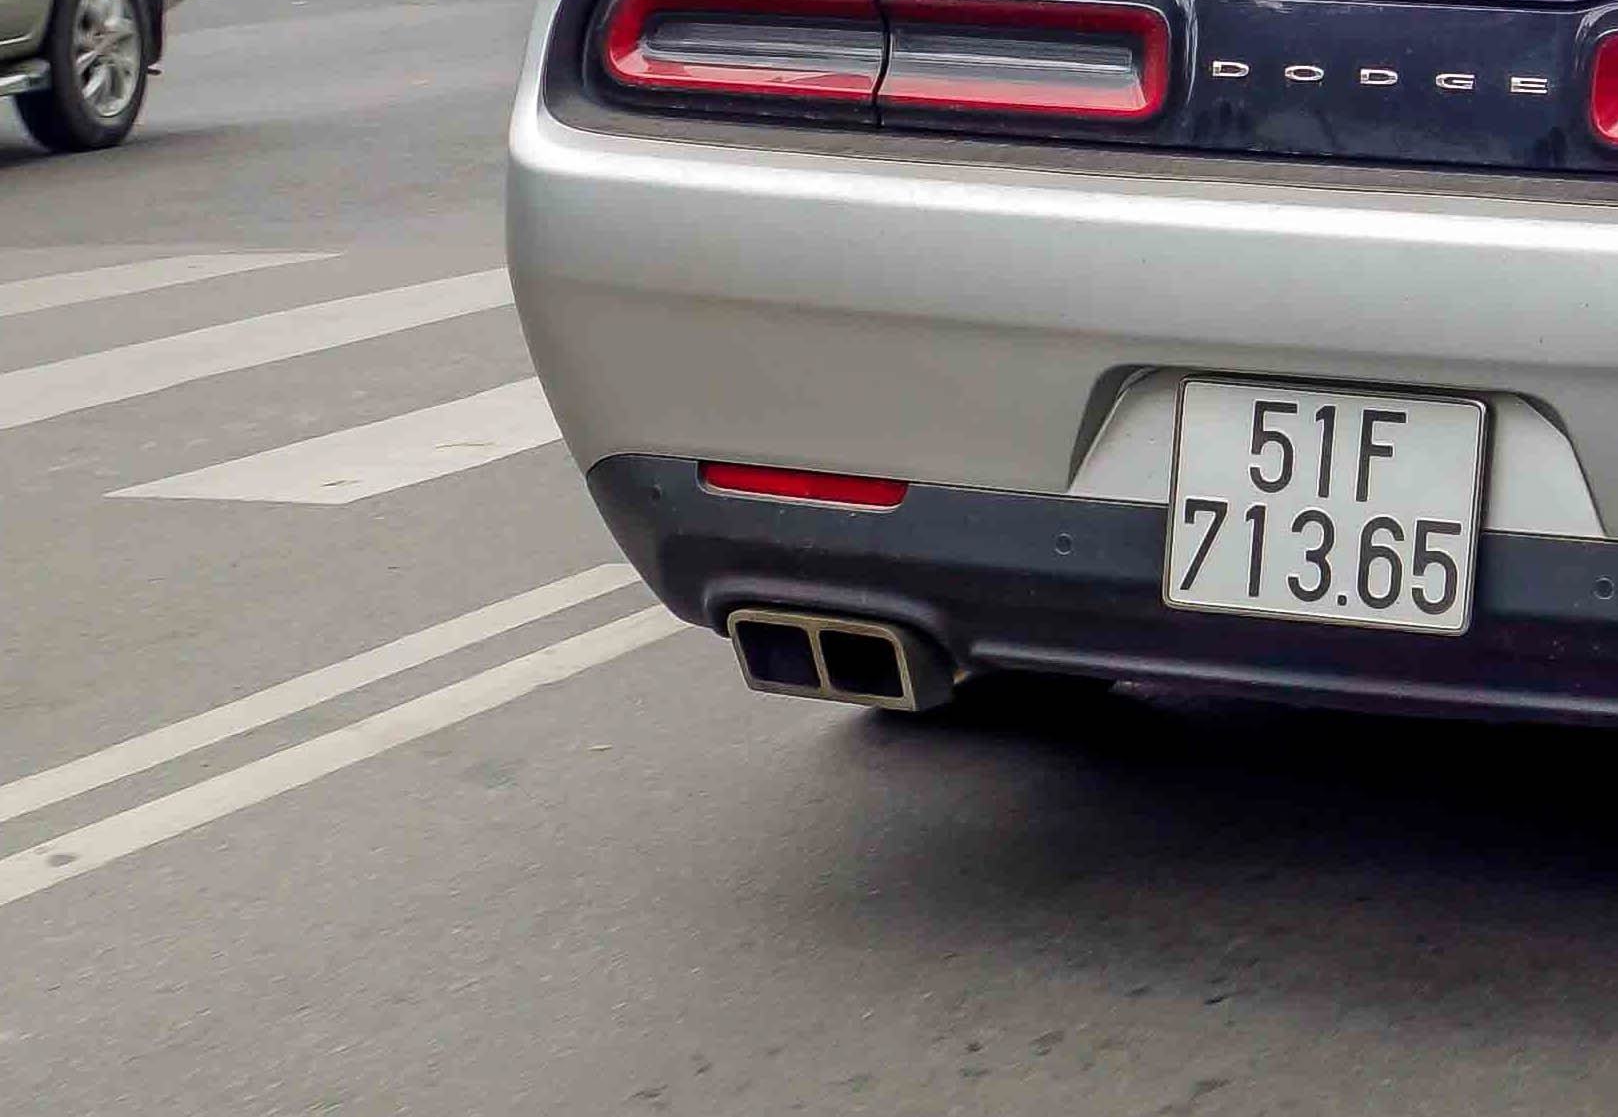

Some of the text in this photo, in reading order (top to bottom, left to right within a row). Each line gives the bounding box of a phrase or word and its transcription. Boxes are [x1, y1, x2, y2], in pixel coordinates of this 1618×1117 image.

[1211, 59, 1550, 96] DODGE
[1249, 399, 1408, 504] 51F
[1179, 497, 1463, 616] 713.65
